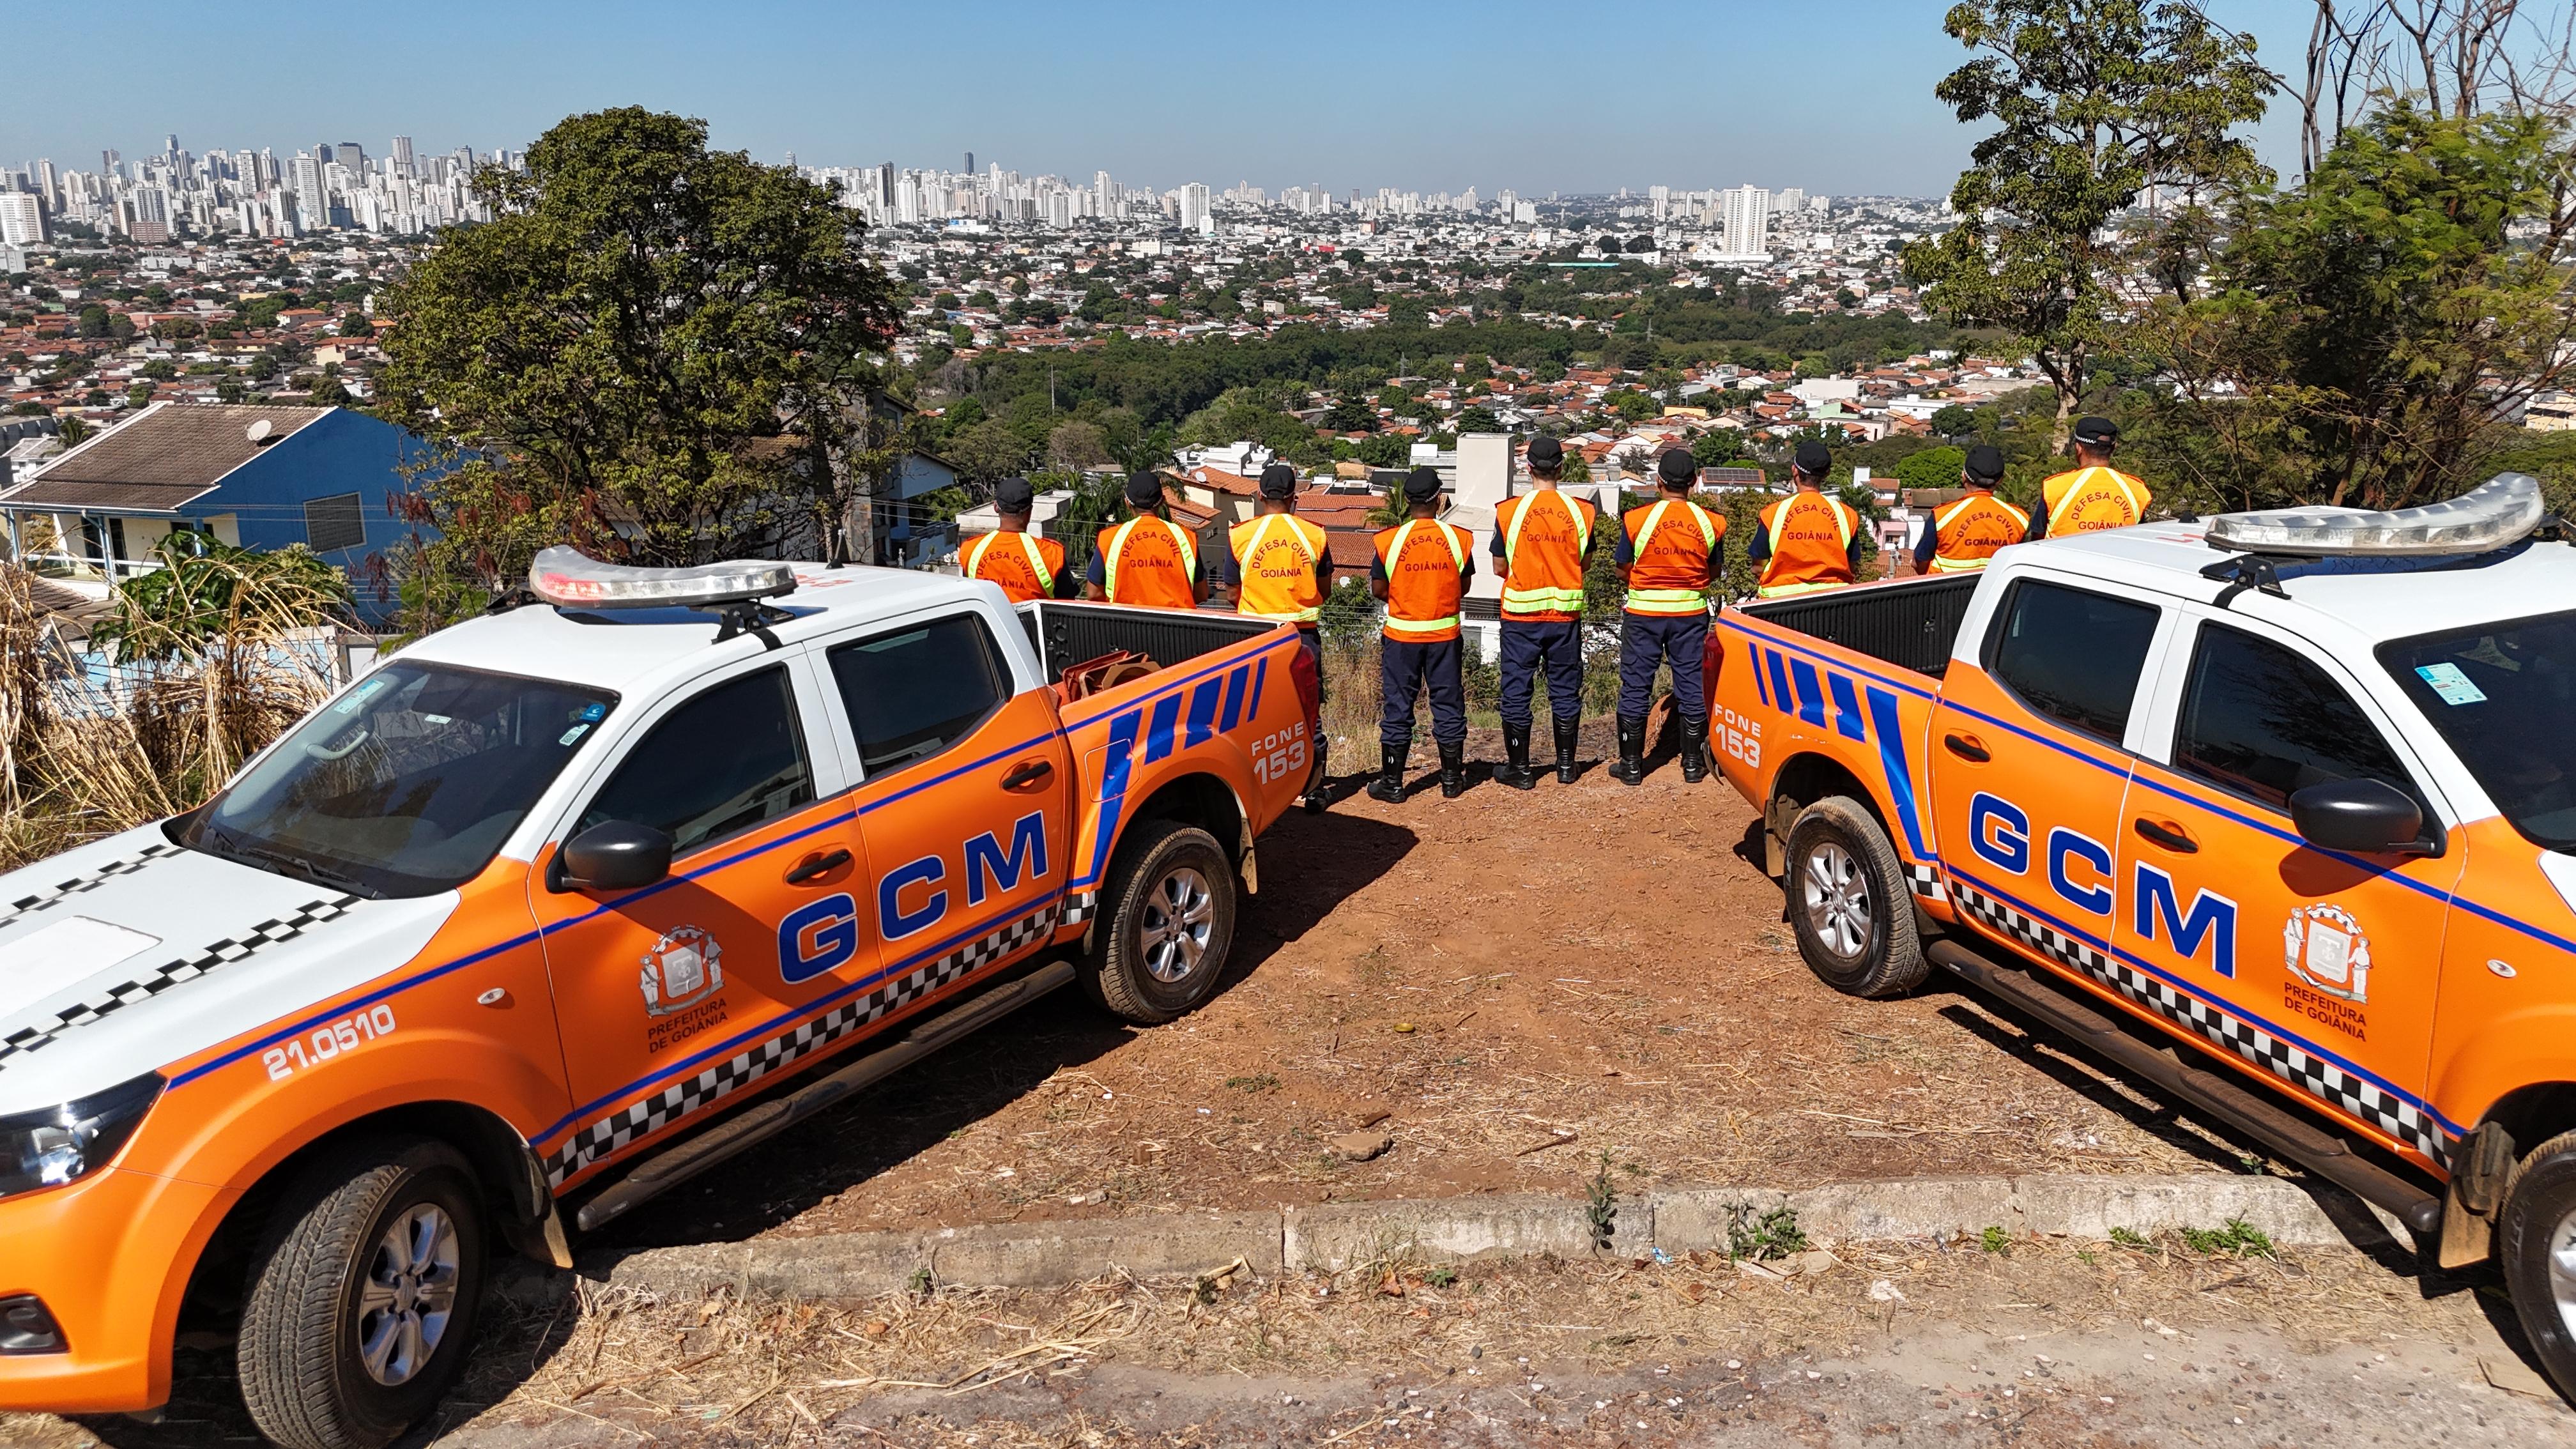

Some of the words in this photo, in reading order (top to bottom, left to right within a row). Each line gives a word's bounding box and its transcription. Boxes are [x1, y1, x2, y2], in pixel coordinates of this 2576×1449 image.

[1782, 504, 1818, 530] DEFESA
[1821, 507, 1840, 532] CIVIL
[2071, 491, 2110, 520] DEFESA
[2114, 495, 2131, 521] CIVIL
[1521, 507, 1554, 532] DEFESA
[1558, 511, 1575, 534] CIVIL
[1649, 520, 1684, 545] DEFESA
[1687, 524, 1706, 547] CIVIL
[1957, 512, 1992, 538] DEFESA
[1997, 515, 2014, 539] CIVIL
[1123, 531, 1157, 558] DEFESA
[1160, 534, 1181, 557] CIVIL
[1399, 535, 1432, 562] DEFESA
[1436, 537, 1453, 560] CIVIL
[1527, 532, 1567, 543] GOIÂNIA
[1788, 530, 1833, 540] GOIÂNIA
[1965, 537, 2007, 546] GOIÂNIA
[977, 551, 1009, 575] DEFESA
[1013, 555, 1034, 579] CIVIL
[1130, 558, 1173, 568] GOIÂNIA
[1252, 539, 1287, 569] DEFESA
[1291, 542, 1310, 568] CIVIL
[1406, 561, 1448, 572] GOIÂNIA
[984, 578, 1025, 590] IÂNIA
[1261, 567, 1301, 578] GOIÂNIA
[1715, 703, 1761, 738] FONE
[1251, 721, 1304, 757] FONE
[1715, 723, 1760, 769] 153
[1254, 740, 1305, 785] 153
[778, 809, 1049, 985] GCM
[1968, 791, 2238, 980] GCM
[2284, 981, 2367, 1027] PREFEITURA
[648, 998, 727, 1040] PREFEITURA
[649, 1039, 668, 1054] DE
[671, 1011, 728, 1043] GOIÂNIA
[2284, 996, 2303, 1014] DE
[2307, 1006, 2366, 1042] GOIÂNIA
[263, 1004, 395, 1081] 21.0510
